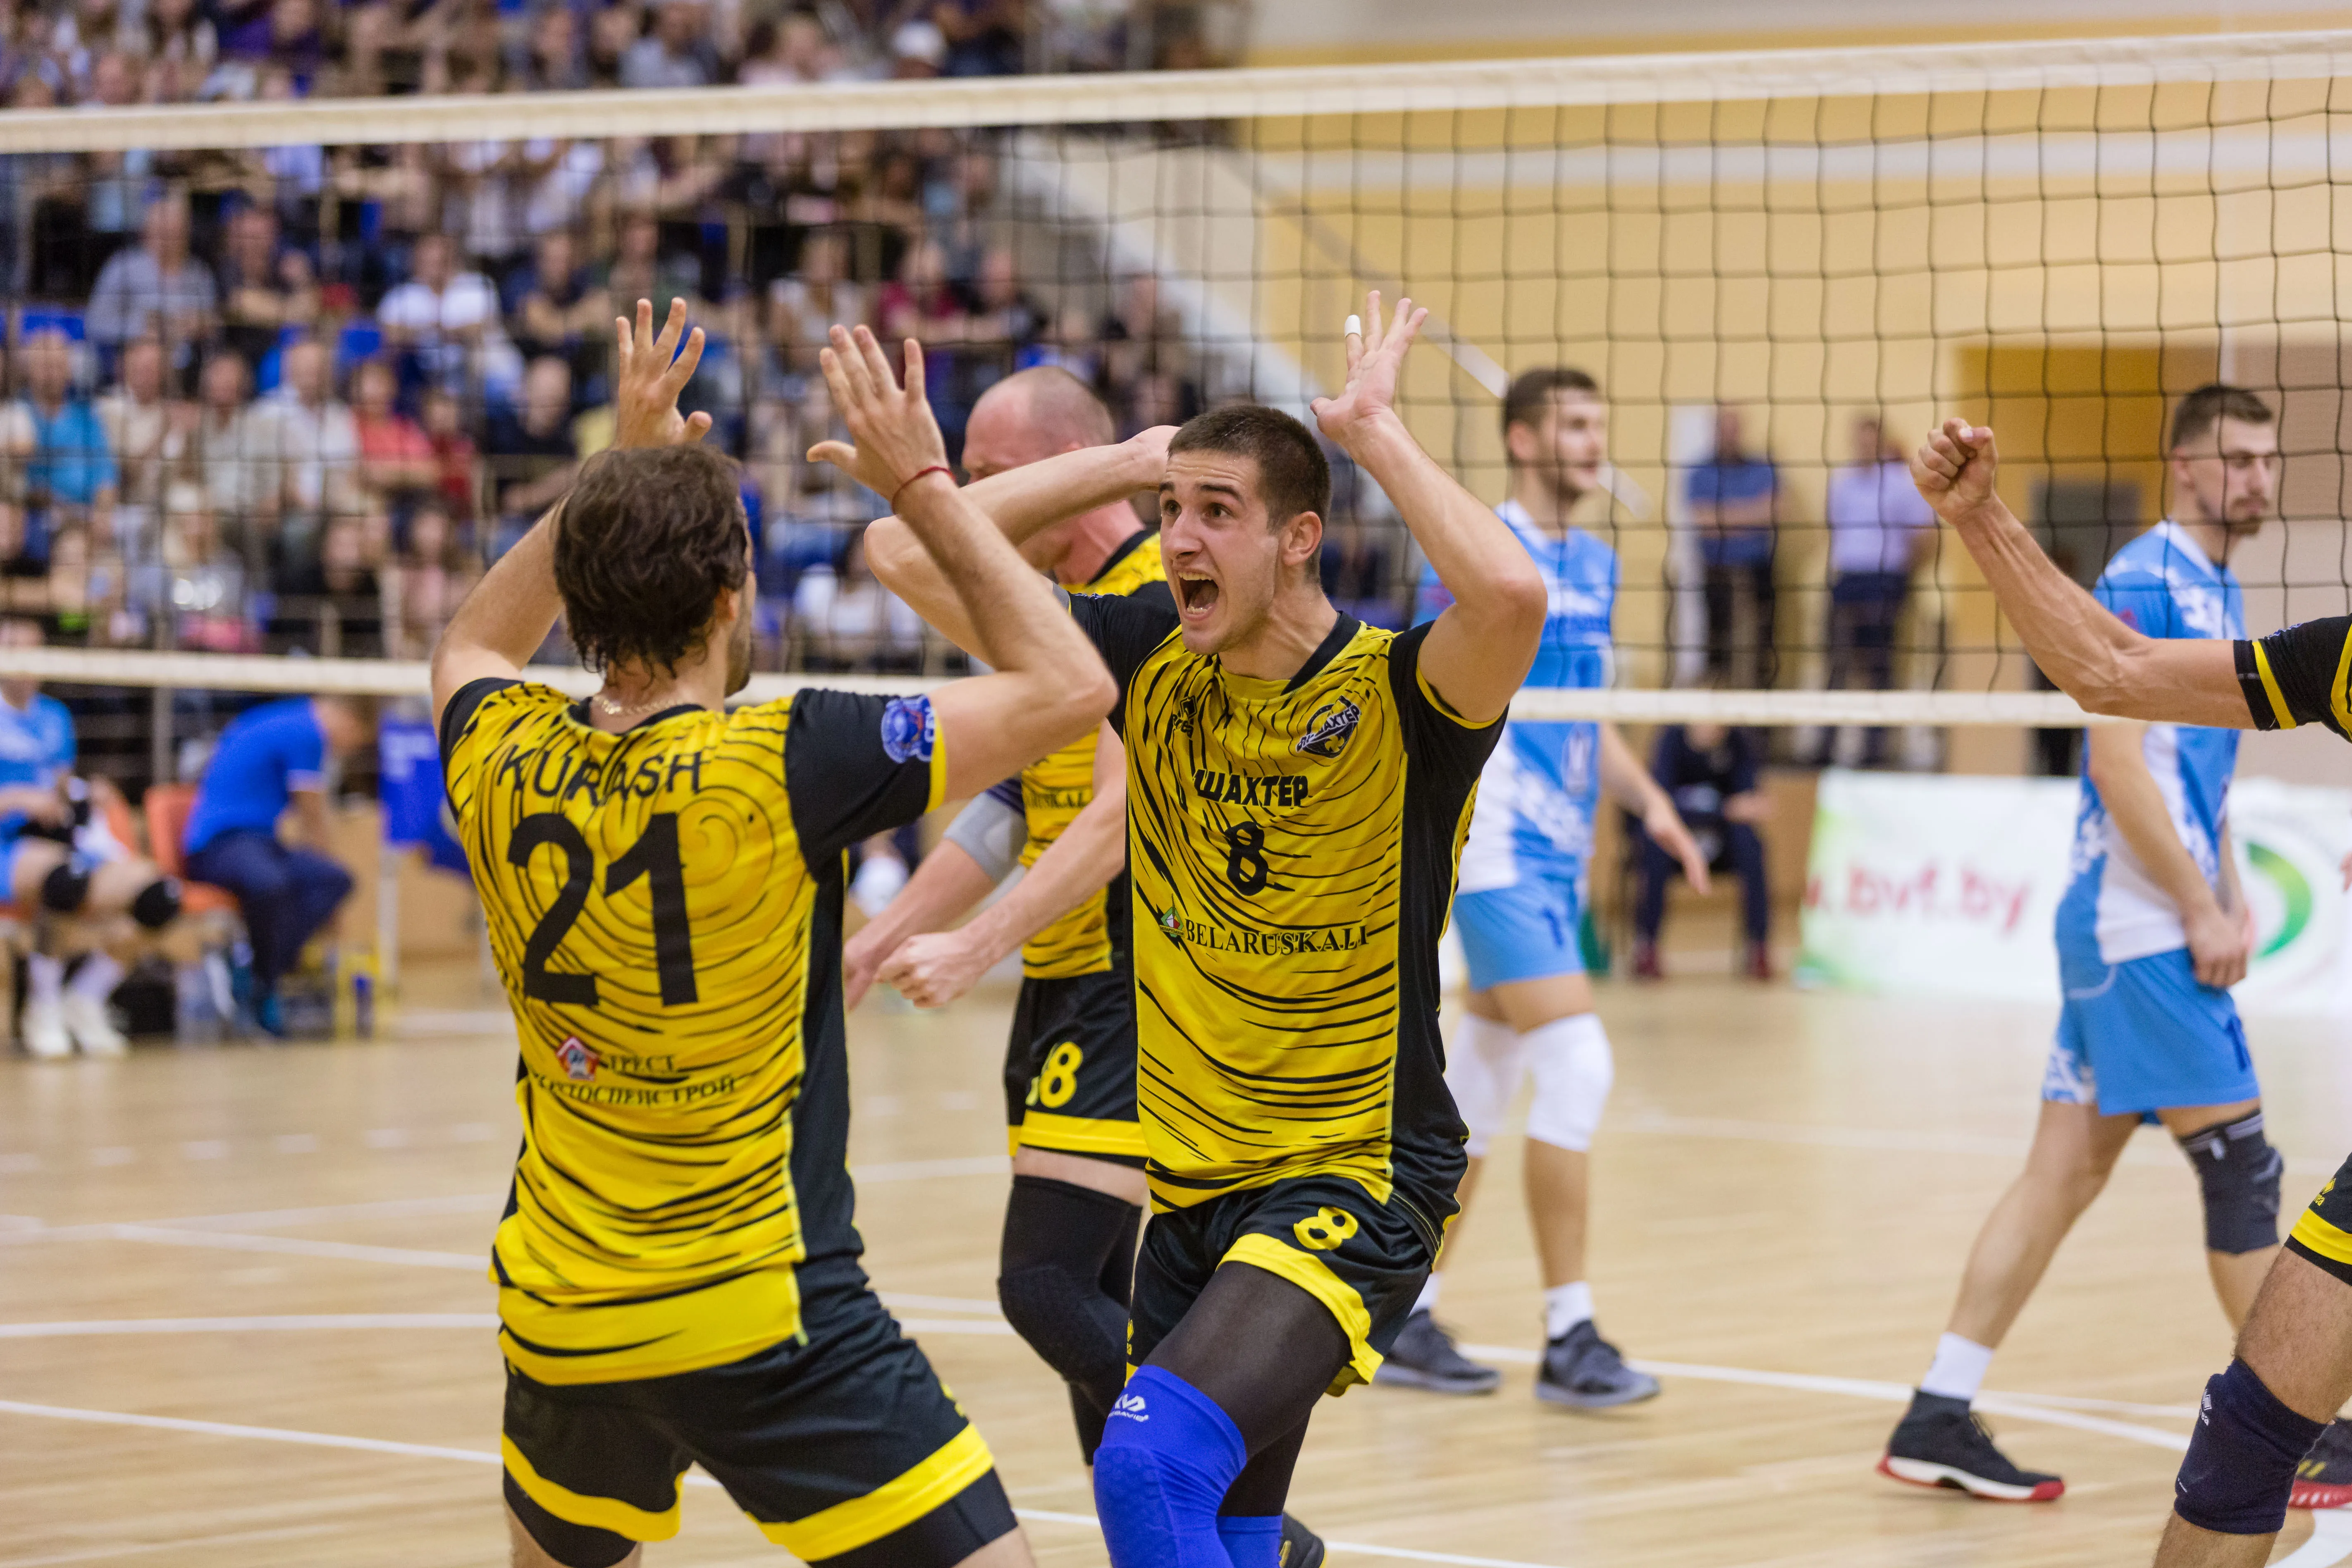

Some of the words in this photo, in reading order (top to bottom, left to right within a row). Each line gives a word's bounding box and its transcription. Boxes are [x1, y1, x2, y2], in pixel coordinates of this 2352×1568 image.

[497, 744, 702, 807] KURASH
[1194, 769, 1308, 806] ШАХТЕР
[1226, 821, 1268, 896] 8
[507, 812, 698, 1006] 21
[1185, 919, 1370, 956] BELARUSKALI
[1294, 1206, 1359, 1251] 8
